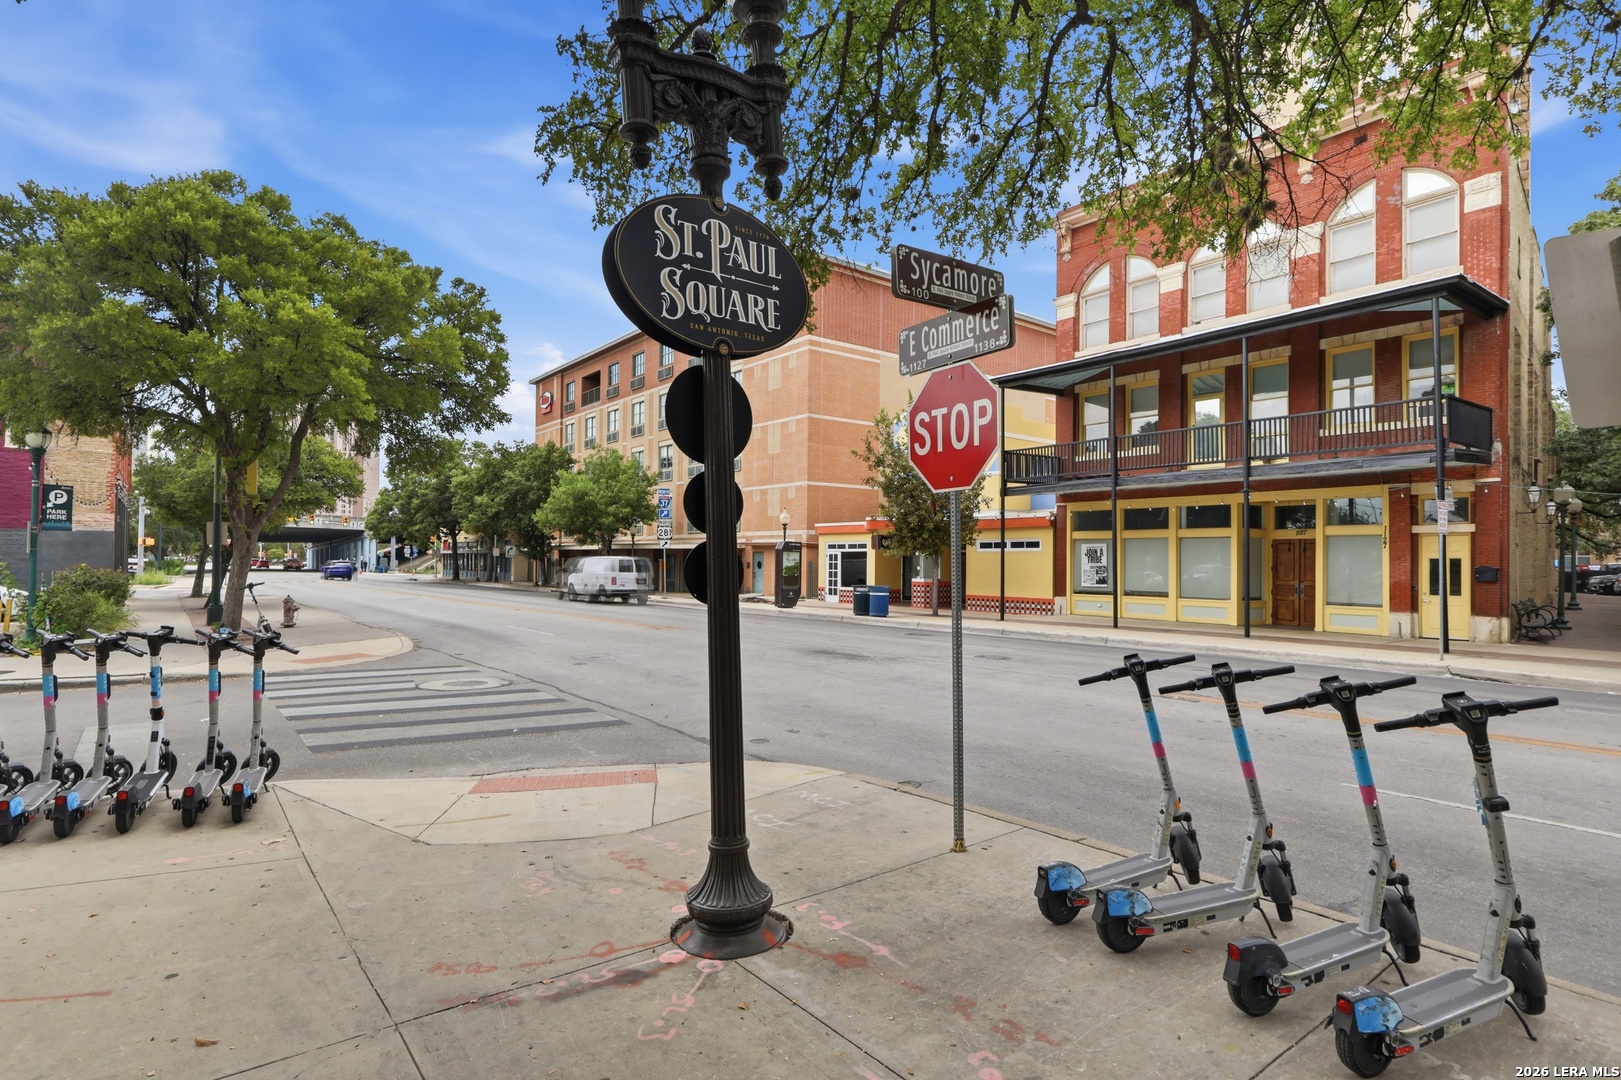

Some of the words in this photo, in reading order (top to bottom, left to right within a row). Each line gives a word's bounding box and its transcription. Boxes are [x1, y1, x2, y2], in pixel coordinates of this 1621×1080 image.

[735, 225, 753, 236] SINCE
[702, 218, 782, 283] PAUL
[910, 251, 997, 298] Sycamore
[660, 266, 781, 333] SQUARE
[911, 287, 929, 299] 100
[690, 322, 704, 331] SAN
[744, 332, 765, 342] TEXAS
[909, 330, 916, 356] E
[921, 306, 999, 353] Commerce
[974, 338, 995, 353] 1138
[909, 359, 927, 373] 1127
[913, 398, 993, 456] STOP
[55, 493, 63, 502] P
[1087, 555, 1102, 564] TRIBE
